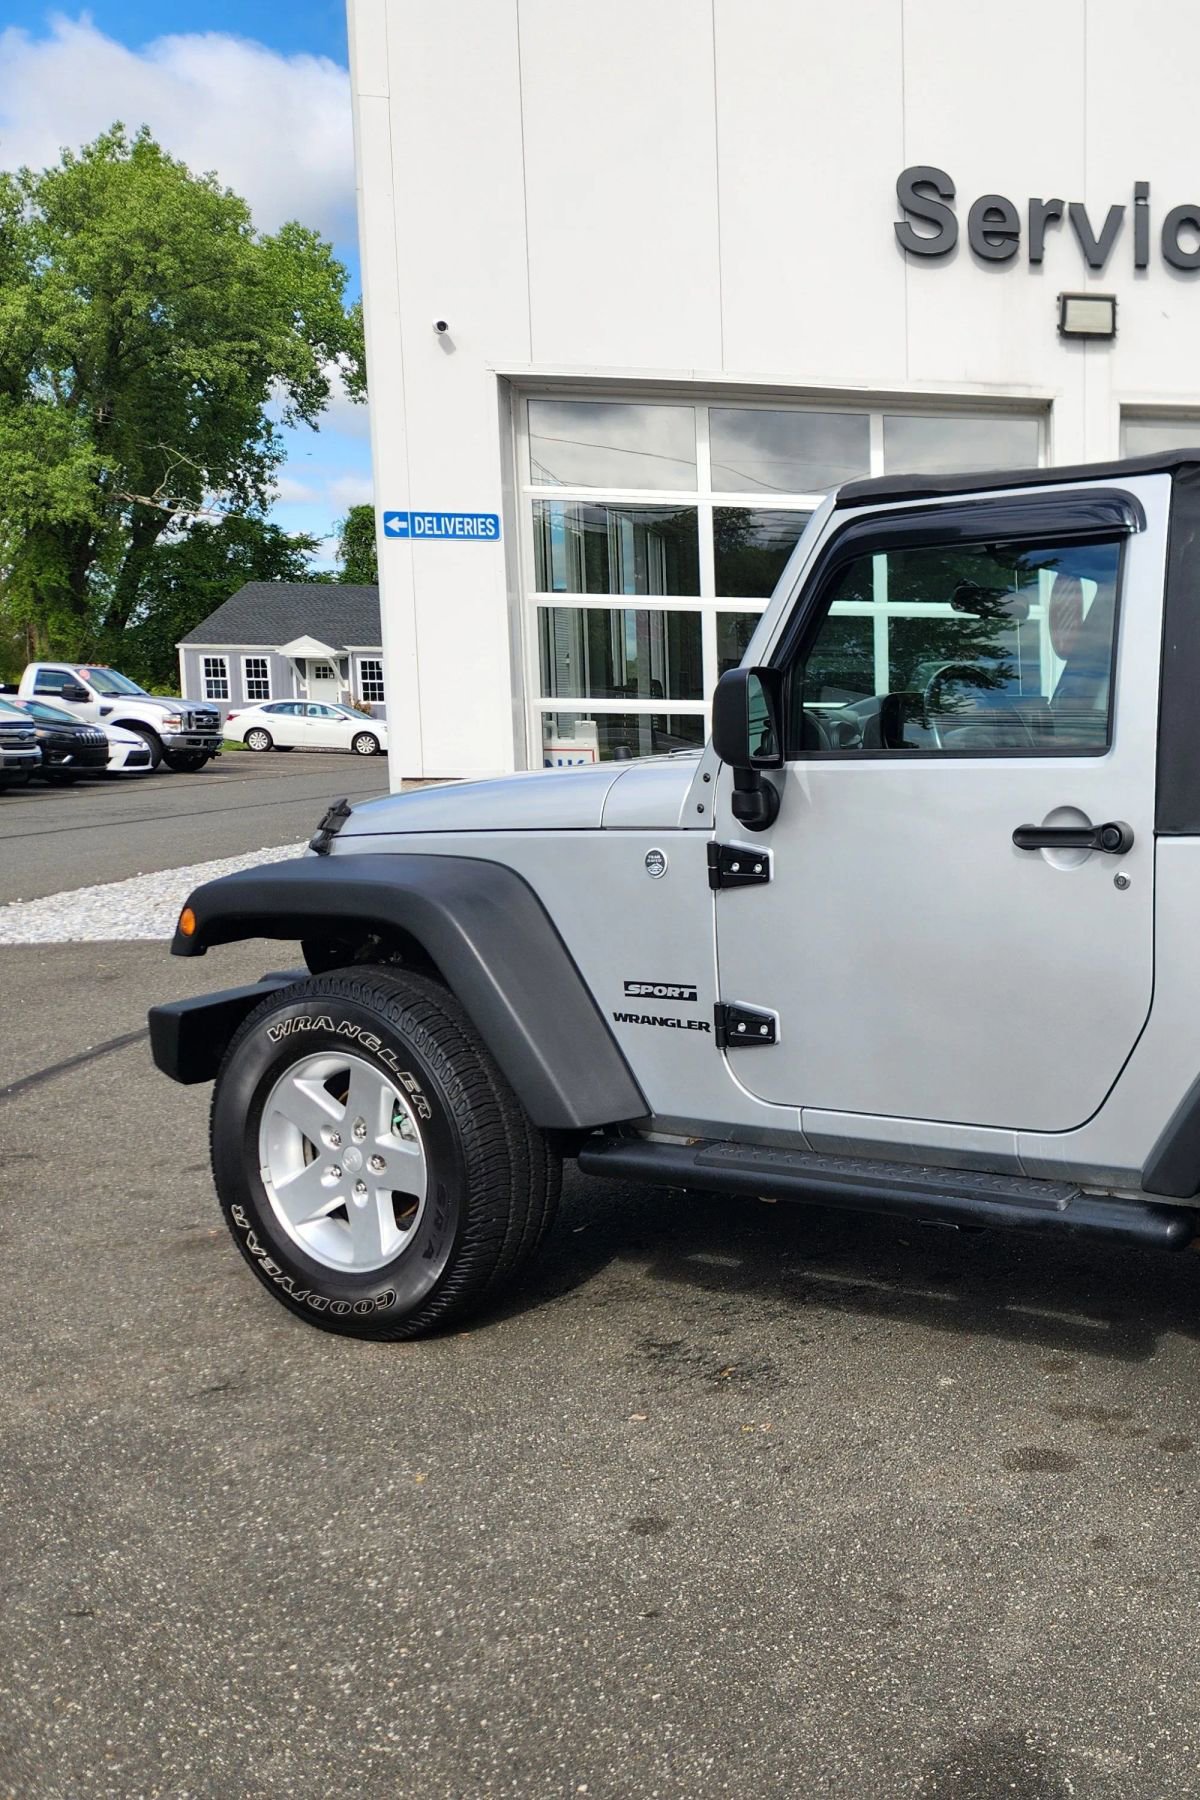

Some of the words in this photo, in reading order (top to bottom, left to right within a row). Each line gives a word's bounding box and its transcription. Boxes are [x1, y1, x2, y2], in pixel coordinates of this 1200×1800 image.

[414, 516, 496, 536] DELIVERIES
[625, 983, 697, 999] SPORT
[613, 1012, 712, 1033] WRANGLER
[266, 1015, 432, 1120] WRANGLER
[230, 1203, 397, 1315] GOODYEAR
